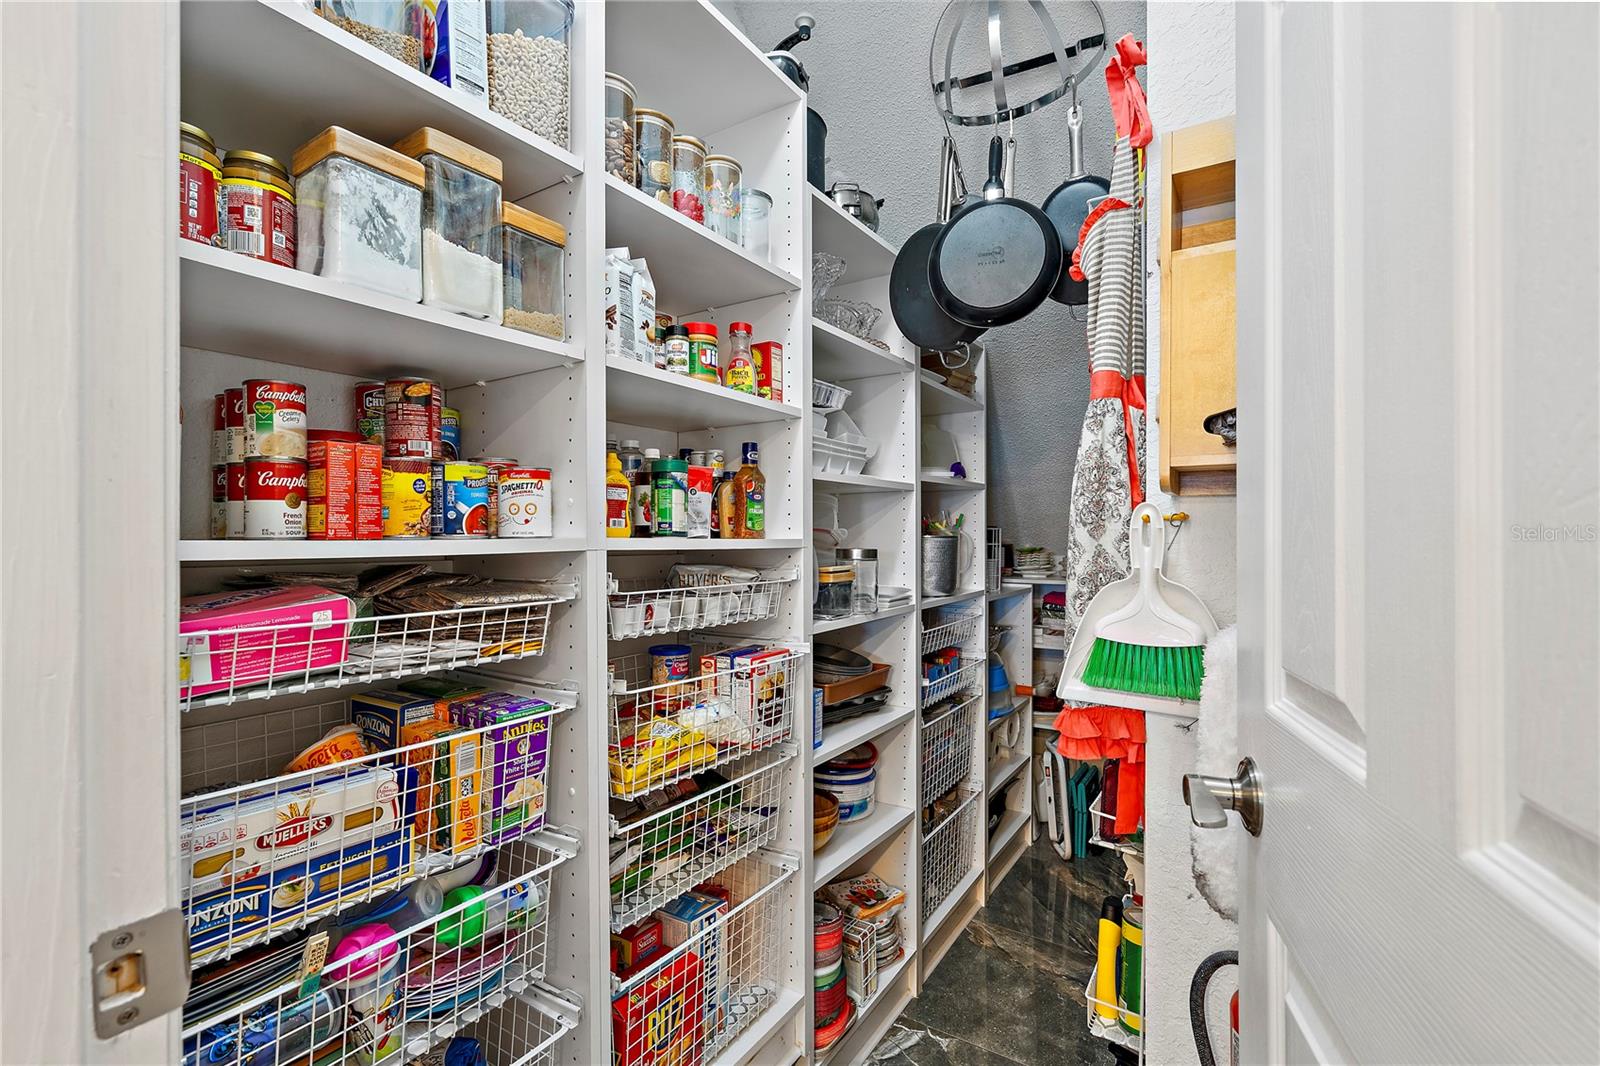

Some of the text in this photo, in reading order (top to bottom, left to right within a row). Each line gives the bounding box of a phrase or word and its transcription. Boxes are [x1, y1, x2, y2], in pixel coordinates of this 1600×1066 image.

[701, 349, 718, 368] Ji
[366, 397, 385, 407] CHU
[257, 471, 307, 489] Campbe
[238, 619, 271, 630] Homemade
[272, 614, 301, 625] Lemonade
[356, 714, 390, 737] RONZONI
[502, 720, 546, 739] Annie's
[188, 894, 259, 929] ONZONI
[647, 992, 685, 1050] RITZ
